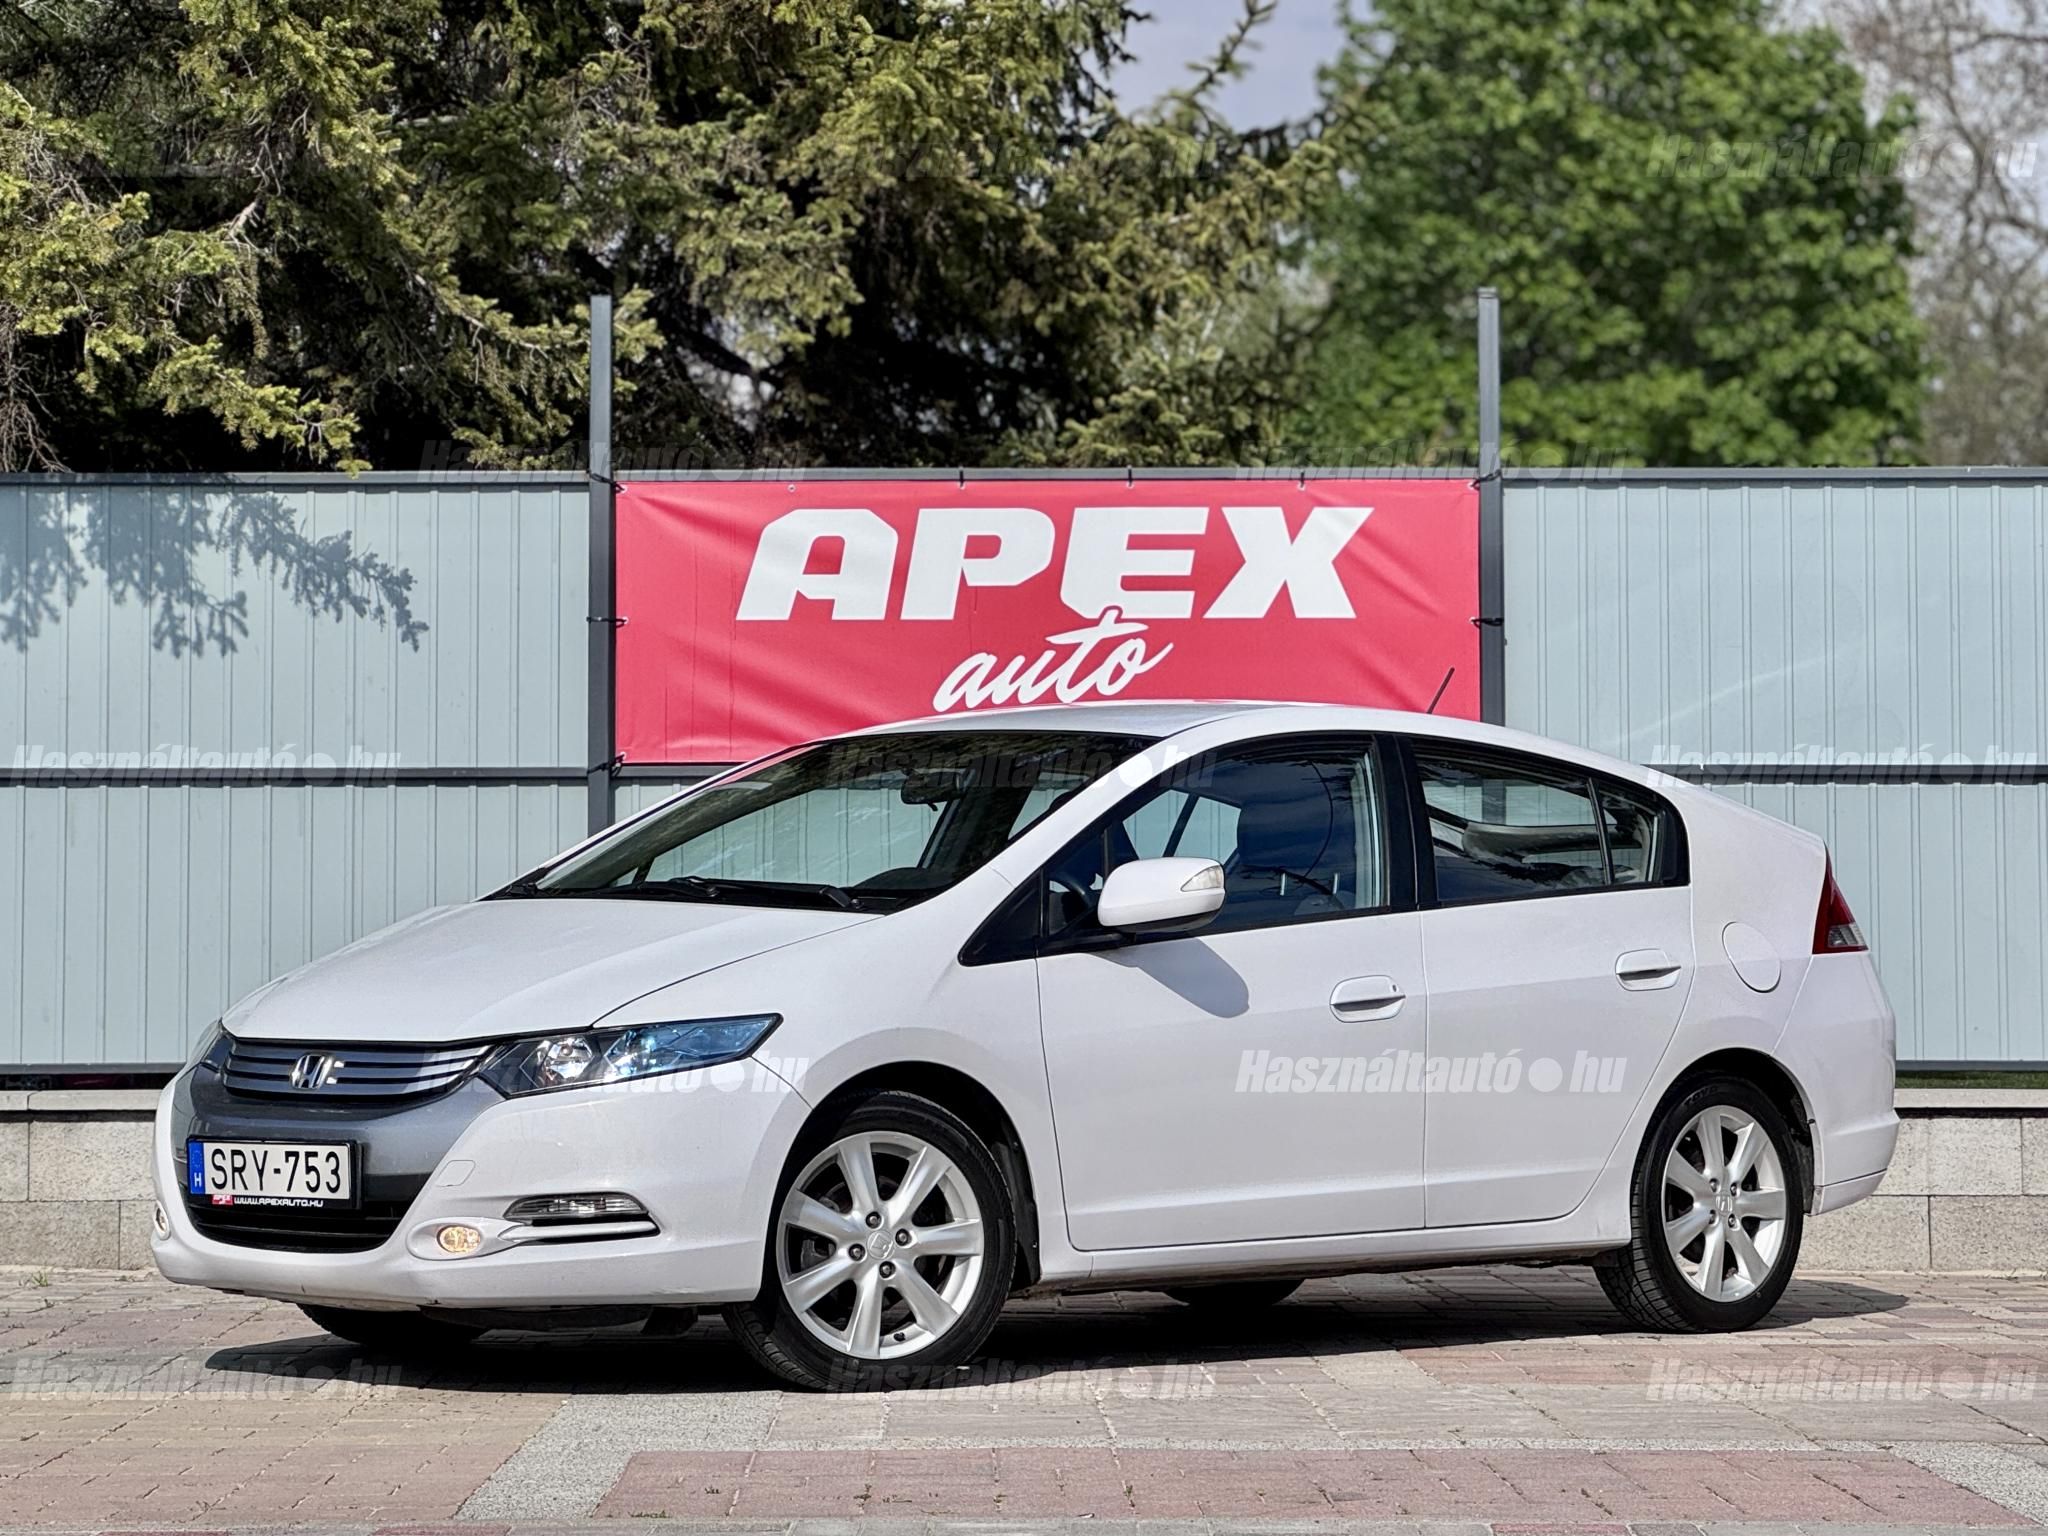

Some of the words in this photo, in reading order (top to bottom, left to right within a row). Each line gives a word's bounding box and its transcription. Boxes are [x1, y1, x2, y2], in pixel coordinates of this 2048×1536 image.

[735, 506, 1374, 621] APEX
[933, 608, 1173, 712] auto
[194, 1172, 202, 1188] H
[211, 1148, 341, 1194] SRY-753
[234, 1197, 324, 1208] WWW.APEXAUTO.HU
